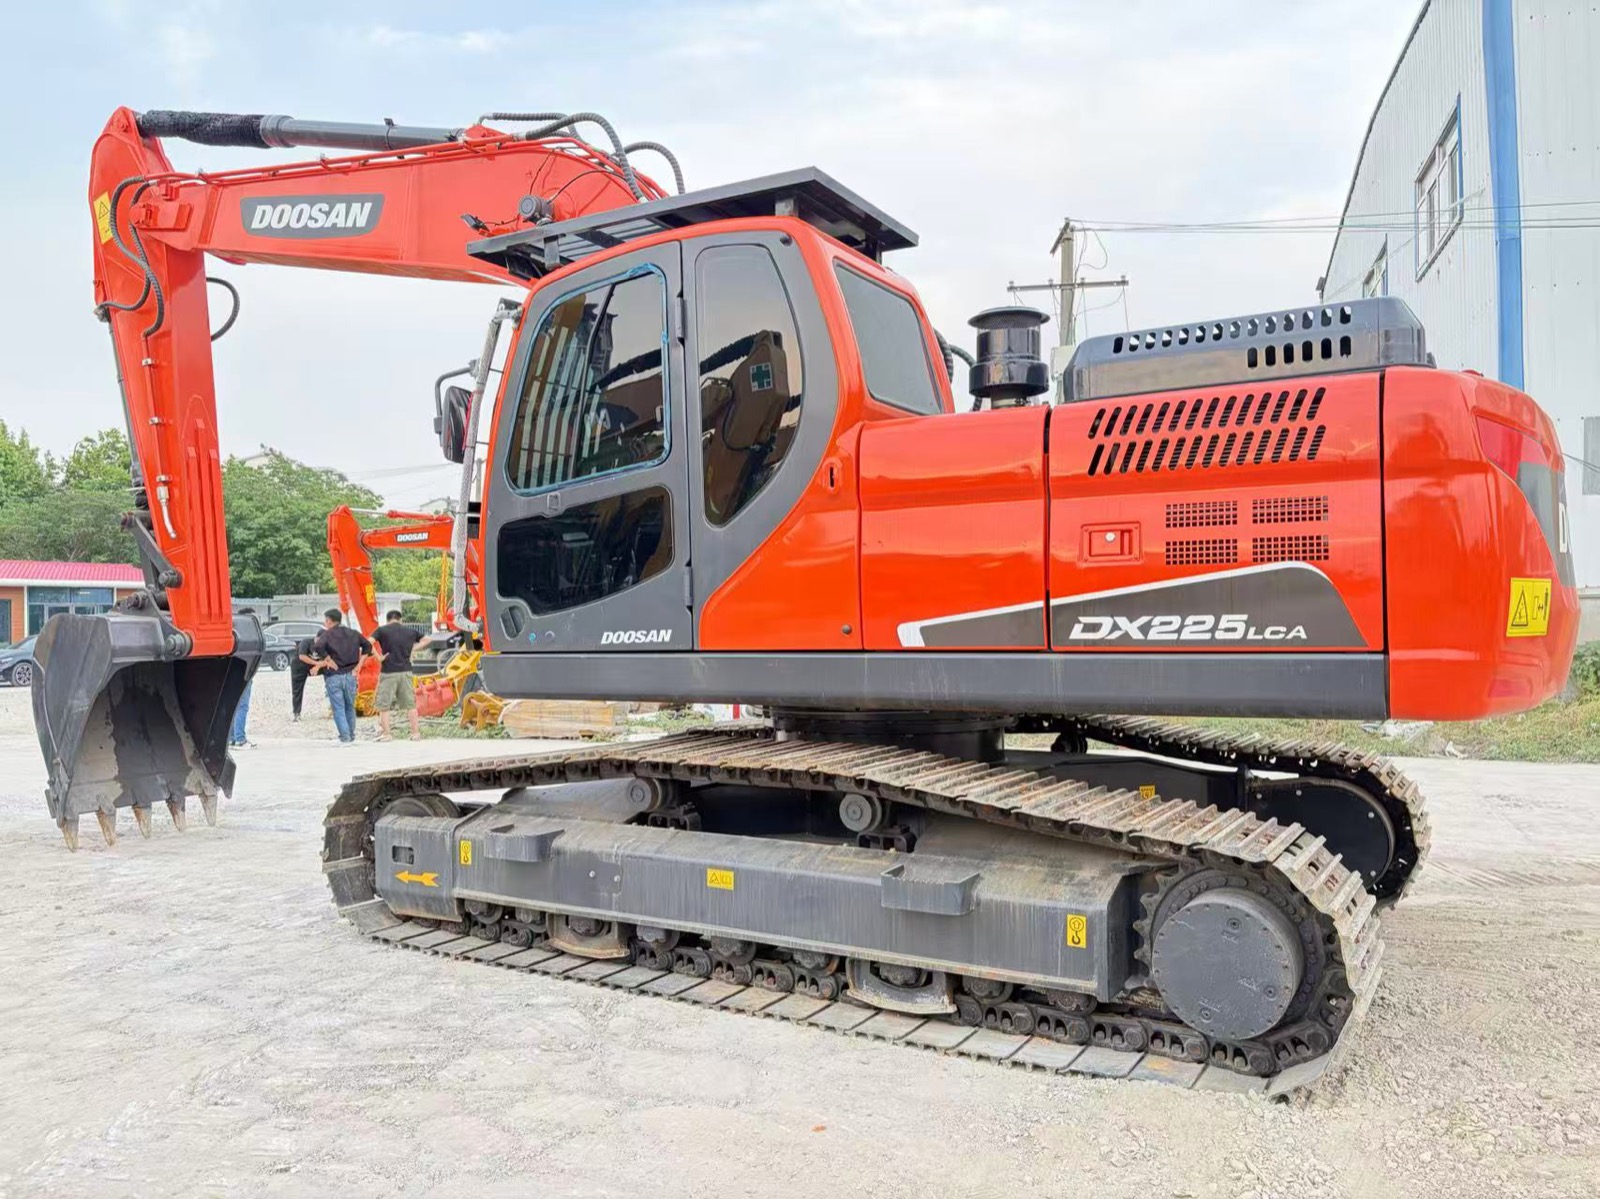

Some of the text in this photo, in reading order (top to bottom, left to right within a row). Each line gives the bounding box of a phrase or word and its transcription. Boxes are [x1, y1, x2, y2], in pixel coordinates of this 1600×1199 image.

[251, 202, 373, 229] DOOSAN
[397, 532, 429, 542] DOOSAN
[600, 629, 672, 644] DOOSAN
